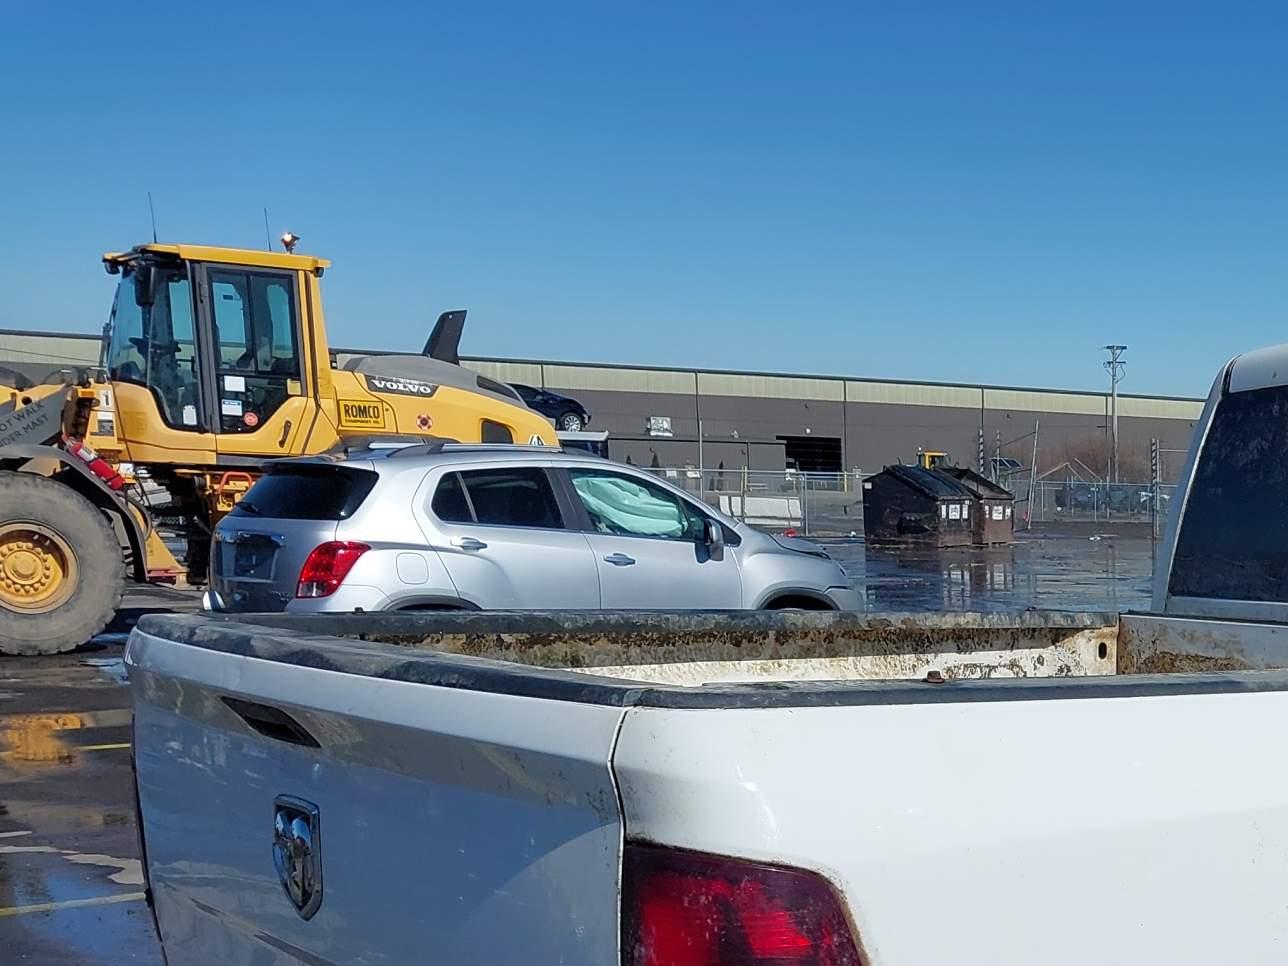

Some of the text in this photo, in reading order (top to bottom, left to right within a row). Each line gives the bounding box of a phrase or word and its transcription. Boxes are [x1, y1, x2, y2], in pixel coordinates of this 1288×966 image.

[371, 379, 431, 394] VOLVO
[14, 401, 45, 421] WALK
[343, 403, 380, 419] ROMCO
[22, 412, 48, 433] MAST
